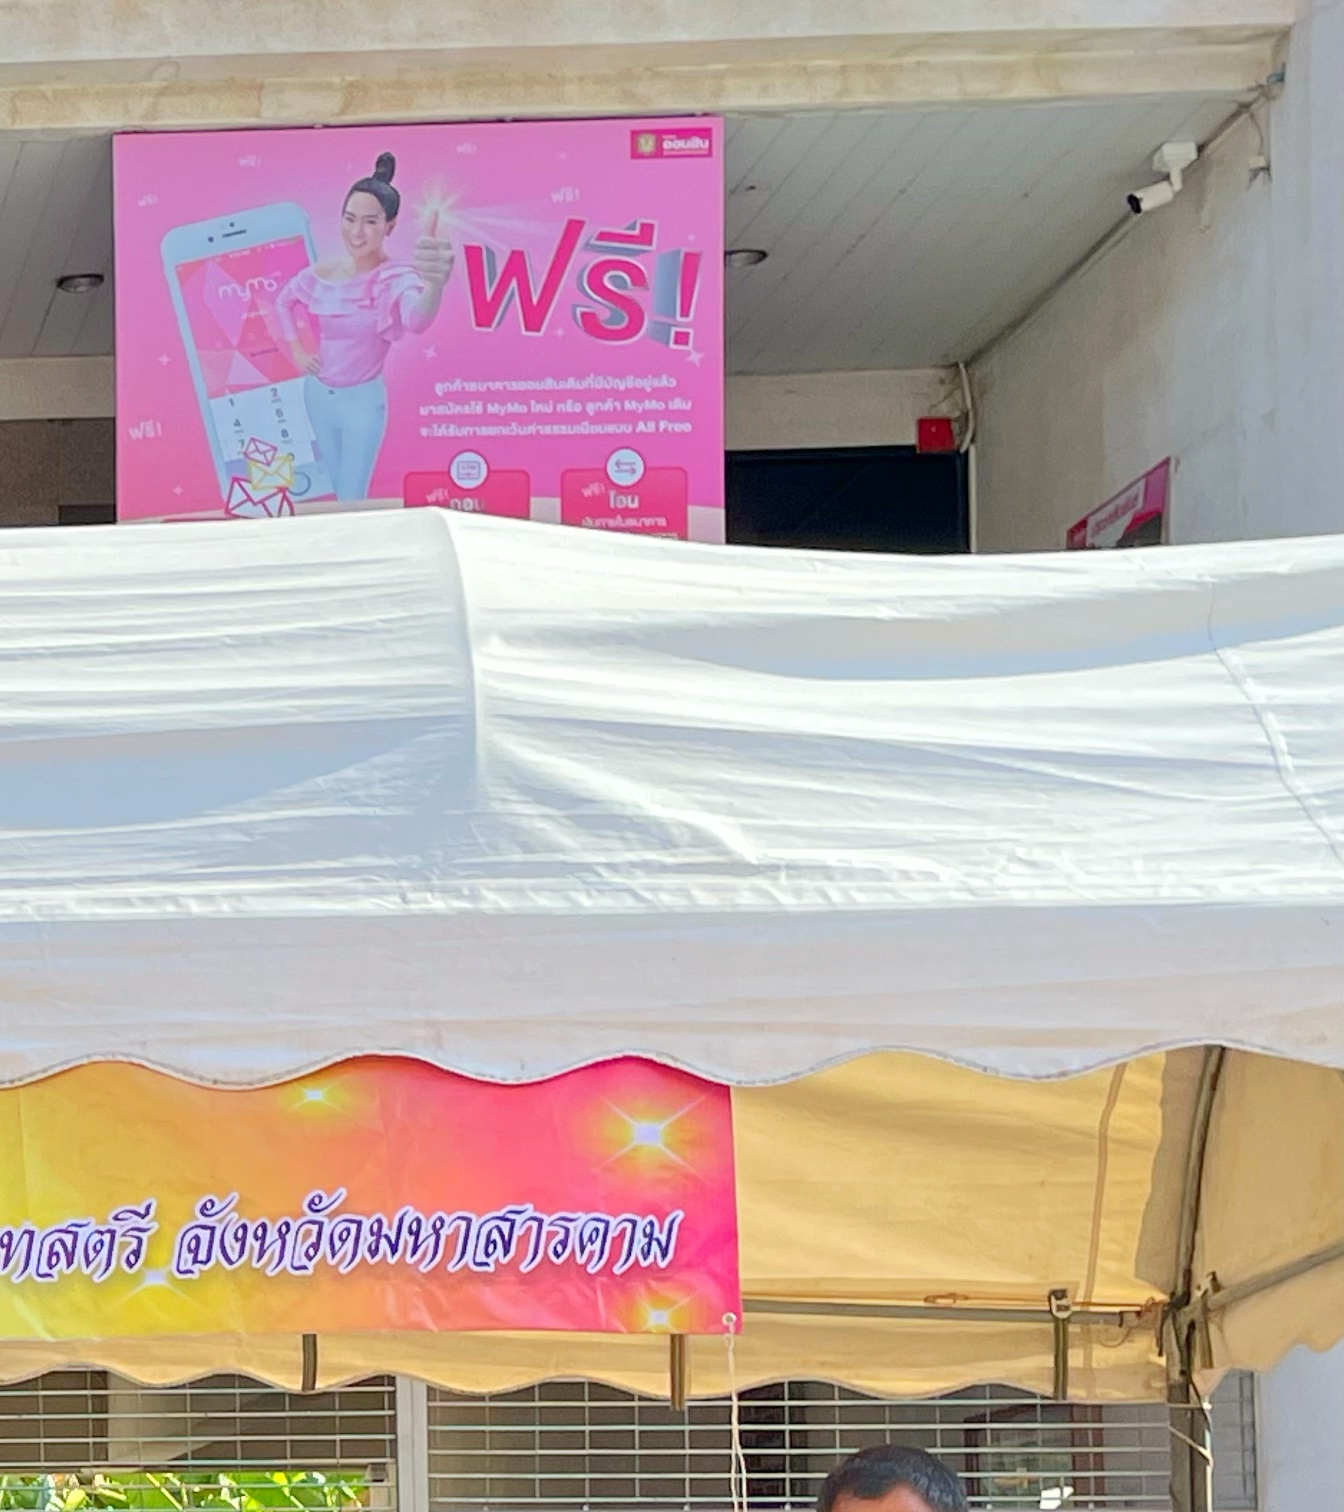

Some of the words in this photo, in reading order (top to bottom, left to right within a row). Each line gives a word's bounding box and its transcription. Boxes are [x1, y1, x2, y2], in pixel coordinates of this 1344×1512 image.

[463, 216, 704, 351] ฟรี!
[174, 1188, 683, 1277] จังหวัดมหาสารคาม
